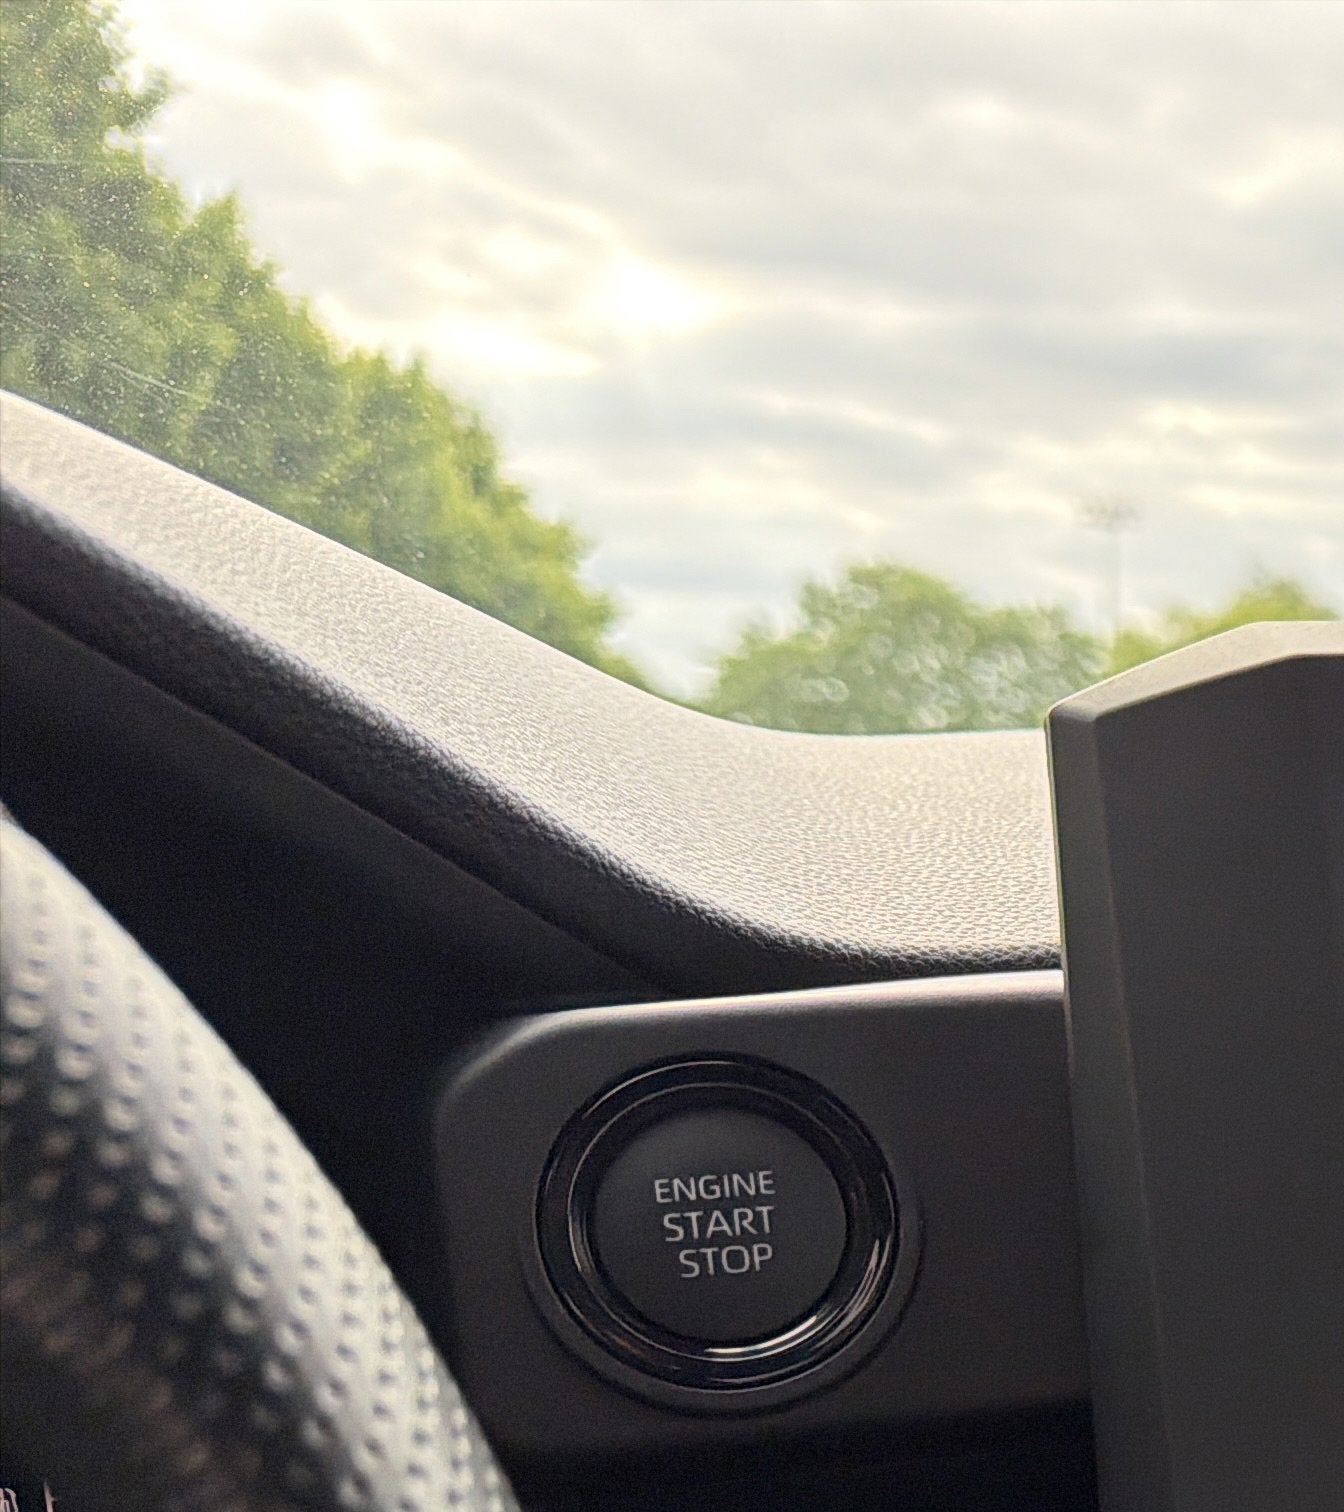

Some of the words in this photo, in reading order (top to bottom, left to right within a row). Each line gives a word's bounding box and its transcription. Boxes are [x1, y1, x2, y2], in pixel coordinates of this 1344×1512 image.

[654, 1170, 777, 1204] ENGINE
[663, 1206, 775, 1242] START
[678, 1243, 773, 1279] STOP
